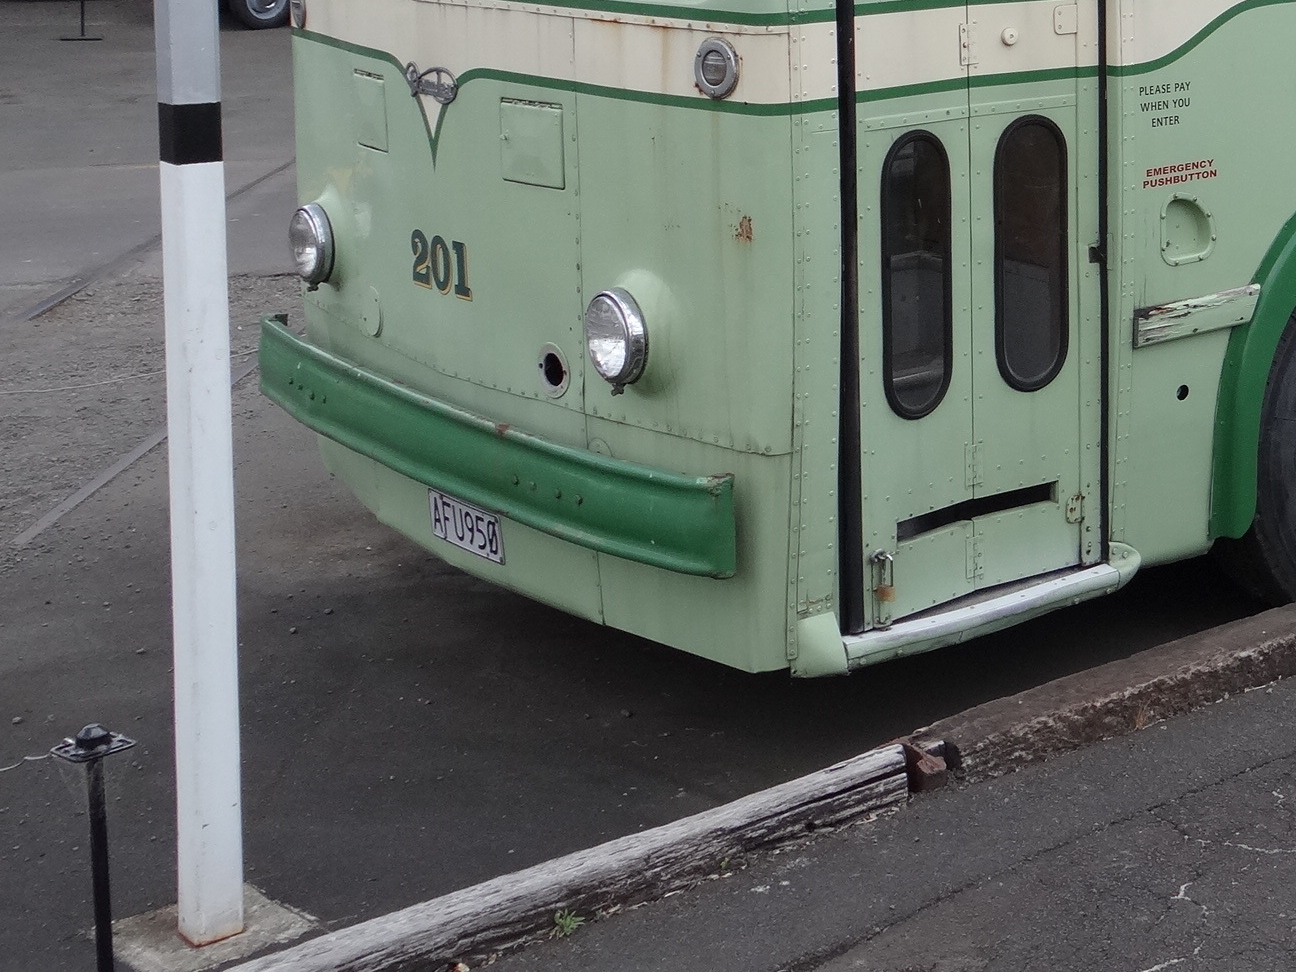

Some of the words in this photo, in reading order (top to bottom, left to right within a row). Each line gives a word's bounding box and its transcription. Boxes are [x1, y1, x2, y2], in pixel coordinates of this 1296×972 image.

[1139, 84, 1171, 96] PLEASE
[1174, 81, 1191, 92] PAY
[1140, 100, 1169, 112] WHEN
[1172, 97, 1191, 108] YOU
[1151, 115, 1180, 128] ENTER
[1146, 159, 1214, 177] EMERGENCY
[1143, 169, 1217, 189] PUSHBUTTON
[411, 229, 473, 302] 201
[433, 496, 499, 555] AFU950
